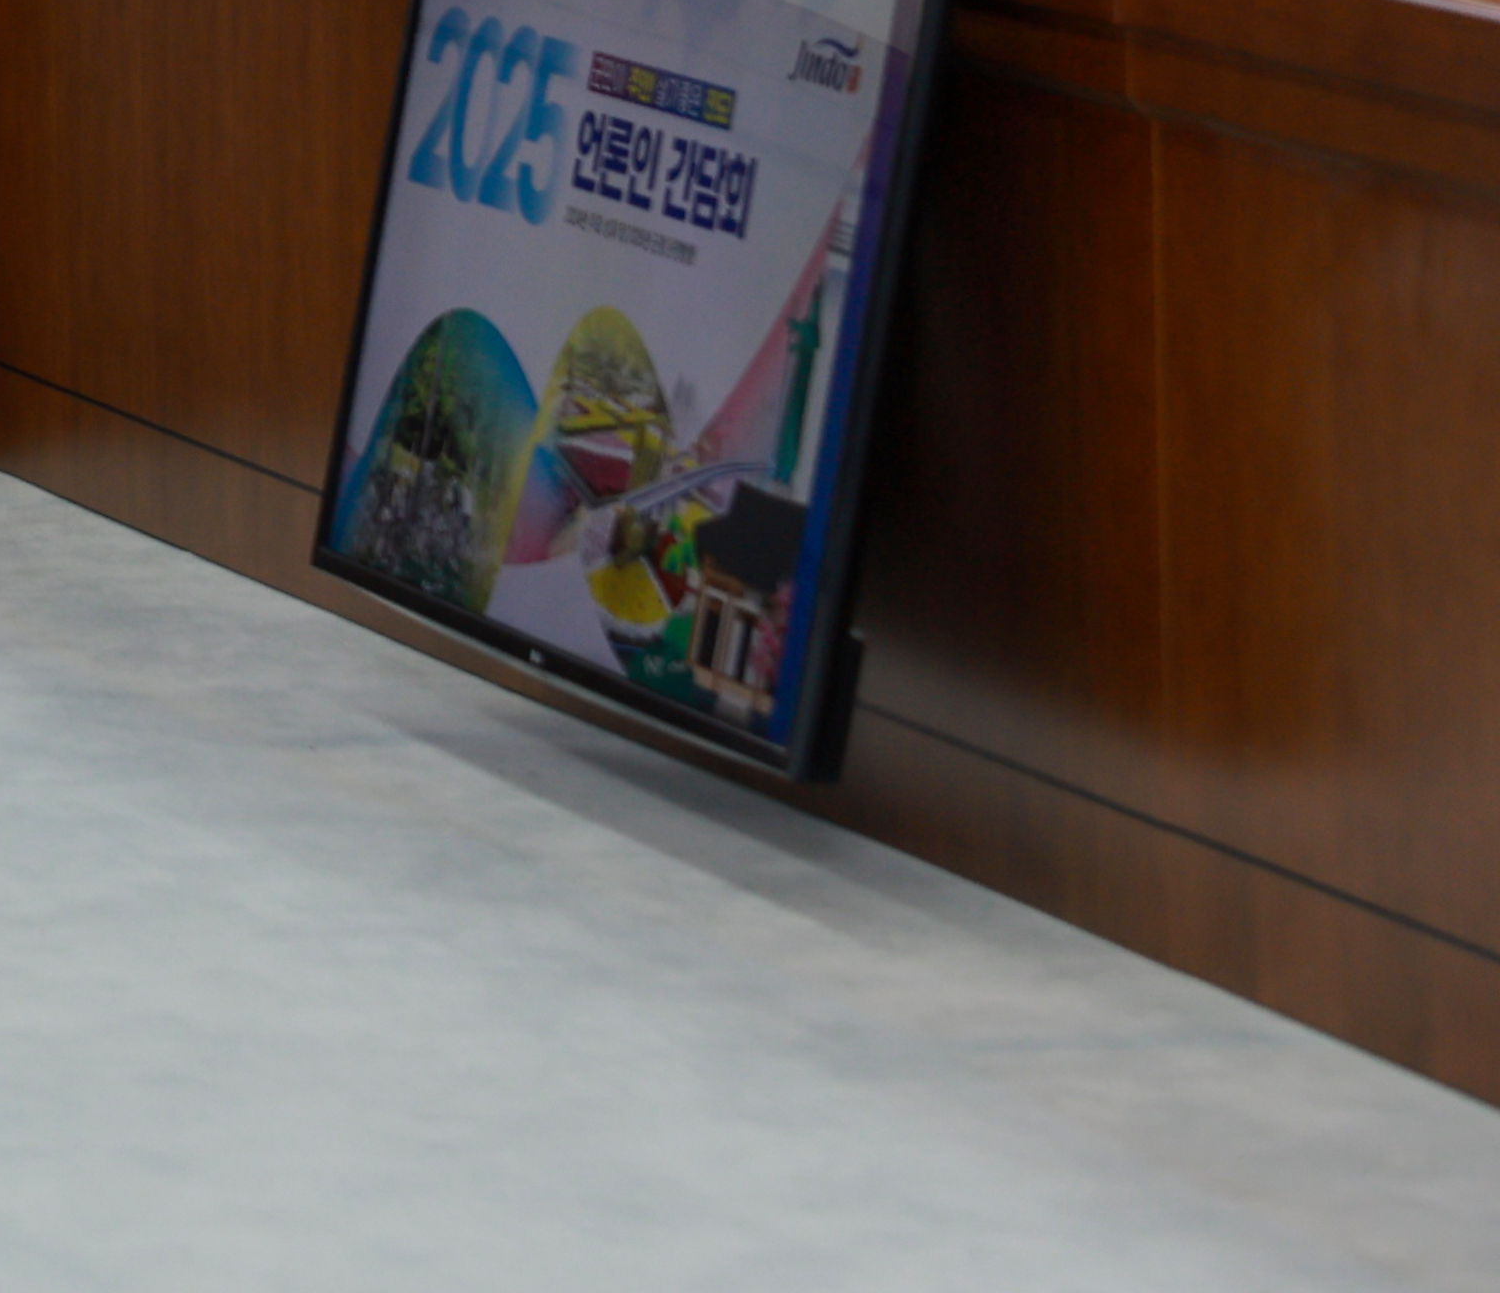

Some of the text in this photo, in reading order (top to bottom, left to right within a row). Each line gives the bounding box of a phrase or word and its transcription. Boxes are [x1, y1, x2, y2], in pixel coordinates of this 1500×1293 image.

[406, 6, 580, 226] 2025
[570, 110, 663, 212] 언론인
[660, 135, 758, 241] 간담회
